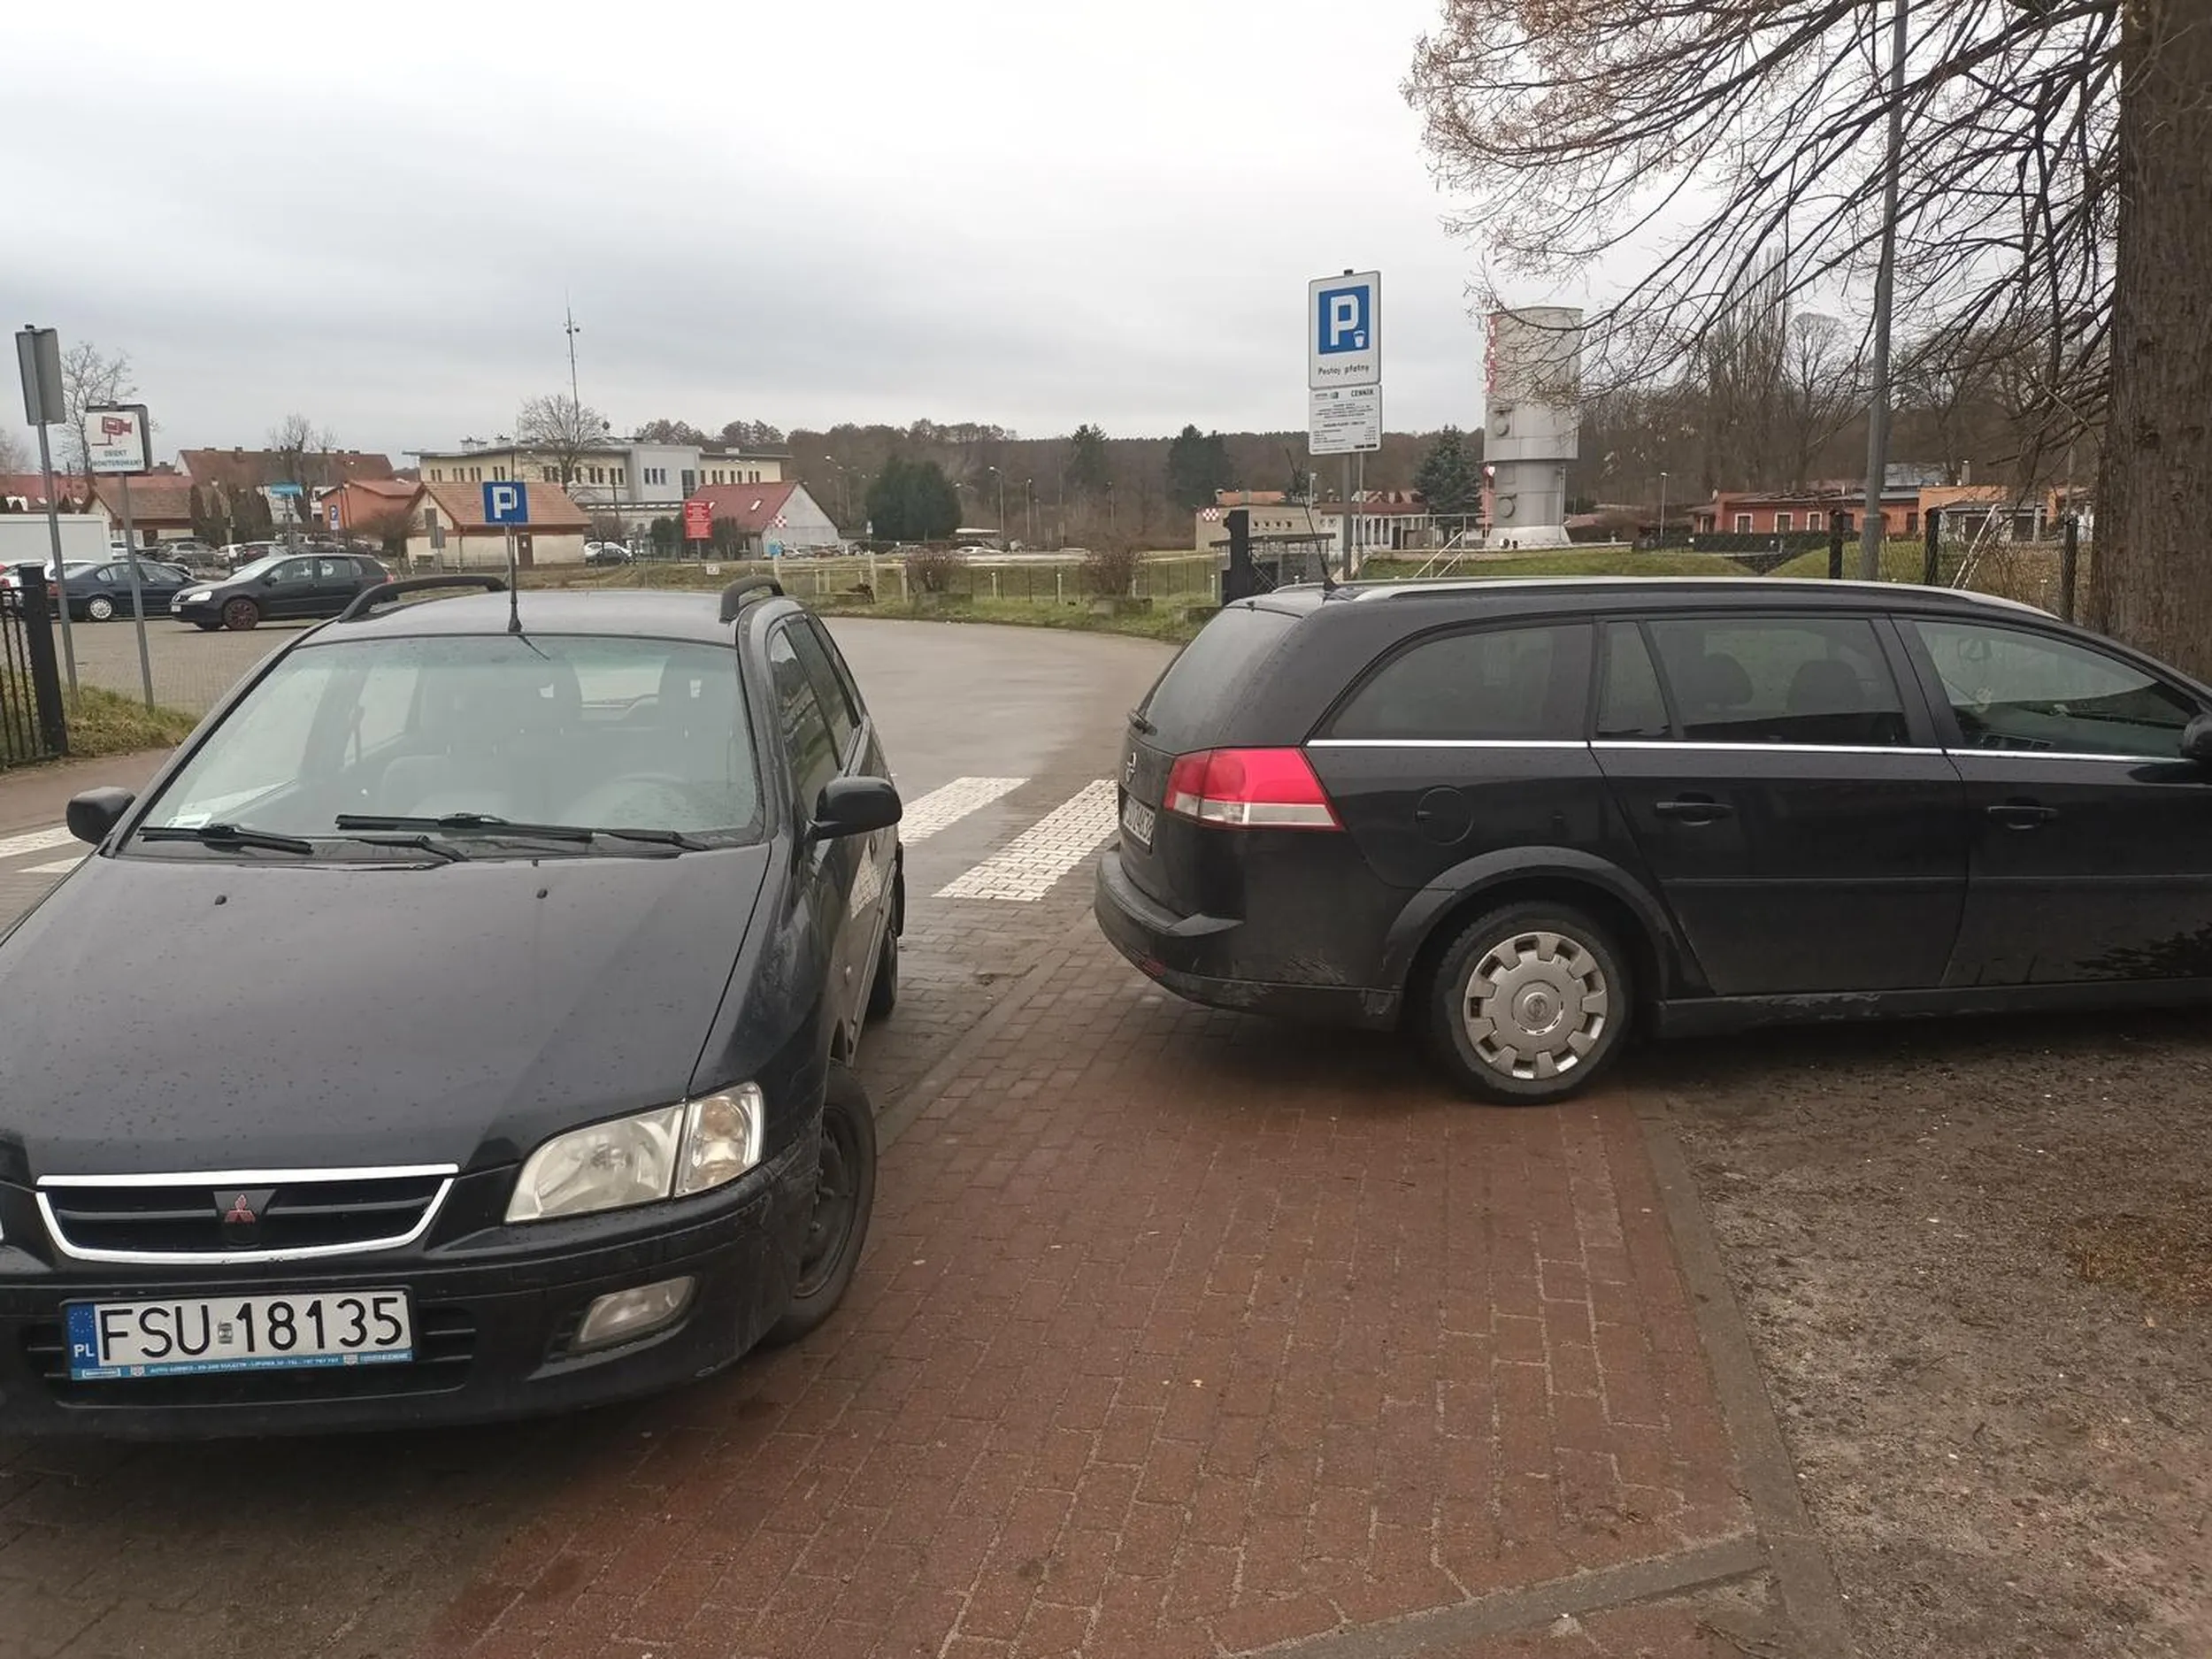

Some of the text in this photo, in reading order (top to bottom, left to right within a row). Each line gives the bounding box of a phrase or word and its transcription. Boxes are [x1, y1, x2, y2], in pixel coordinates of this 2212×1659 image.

[1330, 294, 1359, 346] P
[1317, 366, 1340, 376] Postoj
[492, 487, 518, 519] P
[99, 1296, 403, 1361] FSU 18135
[73, 1343, 95, 1358] PL
